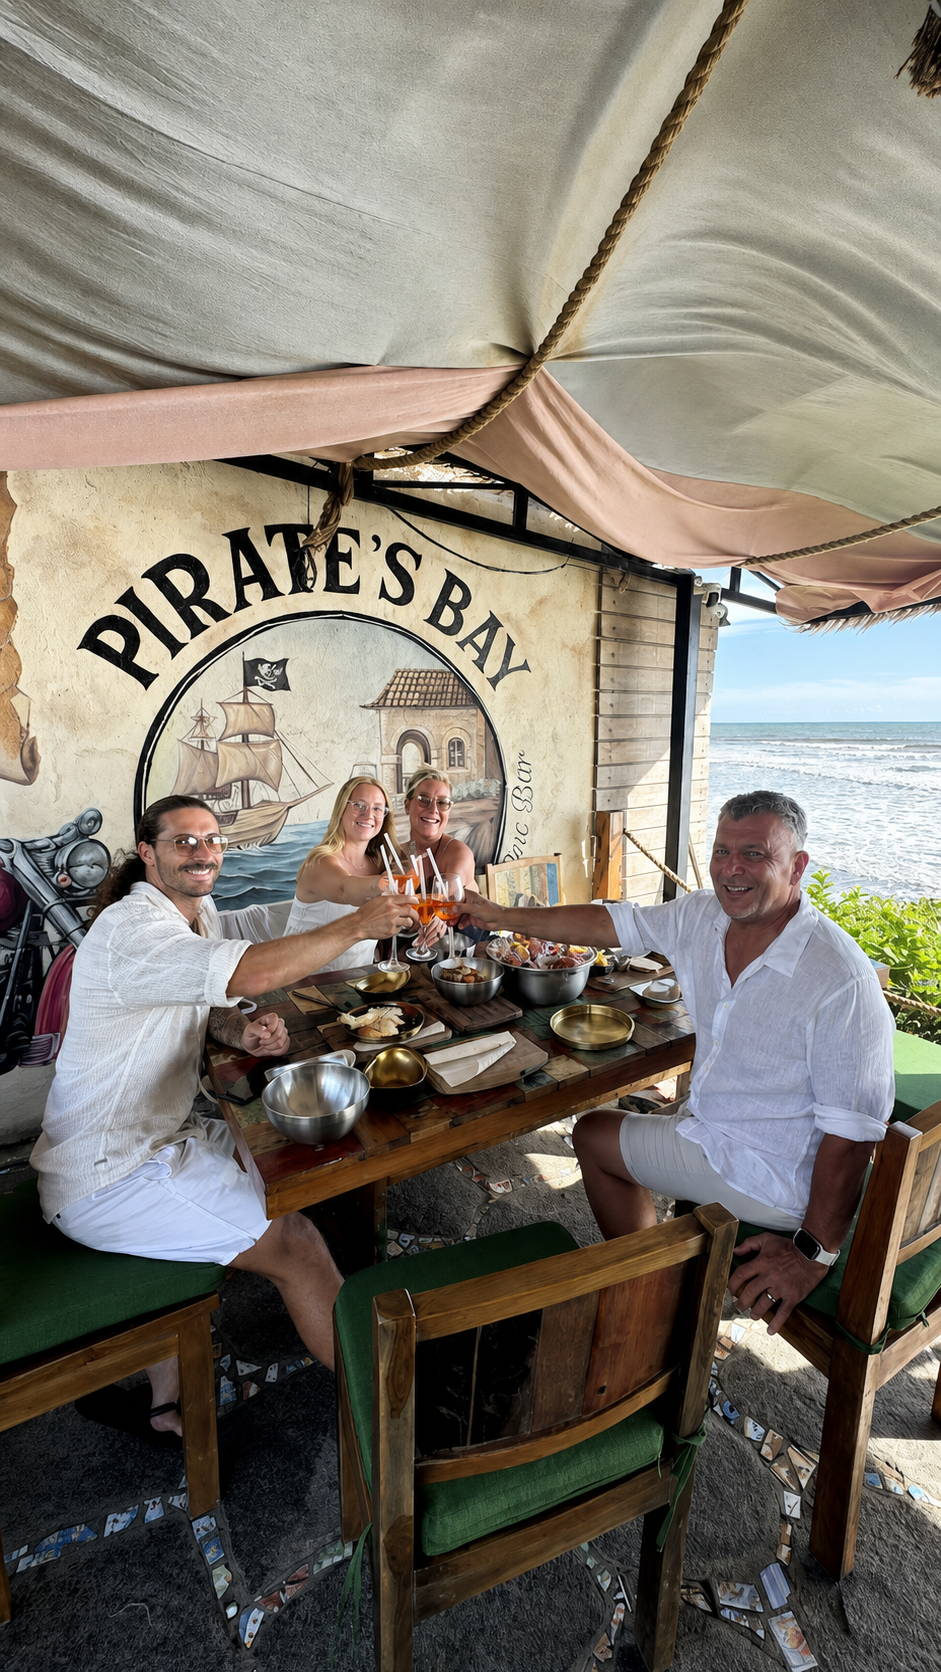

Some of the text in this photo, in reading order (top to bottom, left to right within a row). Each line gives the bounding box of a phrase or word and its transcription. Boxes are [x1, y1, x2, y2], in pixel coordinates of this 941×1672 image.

[77, 523, 531, 691] PIRATE'S BAY
[511, 749, 534, 813] Bar
